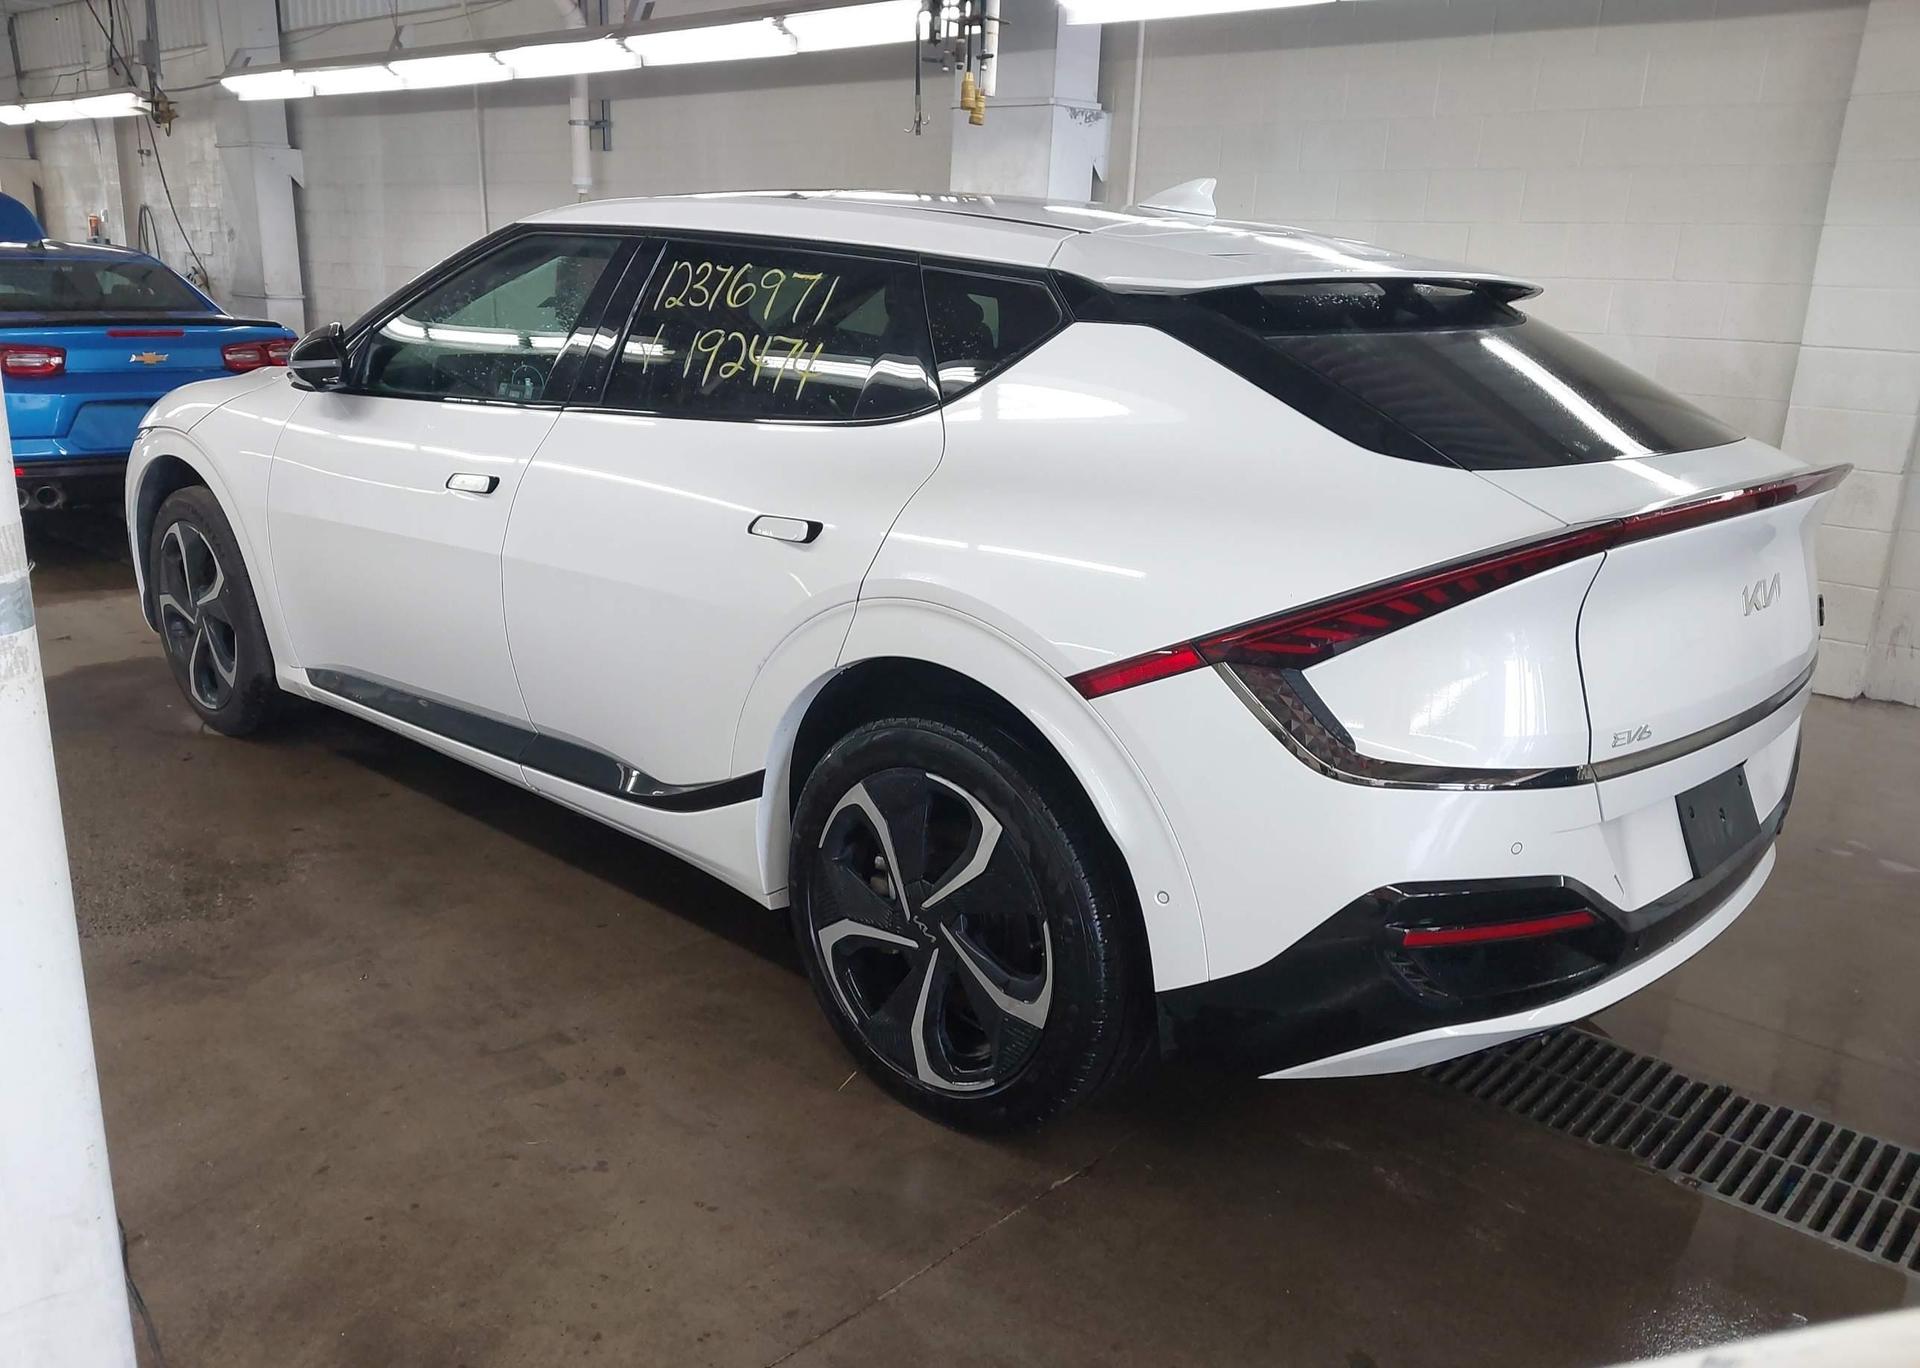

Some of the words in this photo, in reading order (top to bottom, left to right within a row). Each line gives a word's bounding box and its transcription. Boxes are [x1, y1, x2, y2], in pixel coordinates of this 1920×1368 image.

[653, 260, 840, 325] 12376971
[683, 328, 824, 400] 192474
[1741, 572, 1781, 617] KIA
[1611, 723, 1652, 748] EV6
